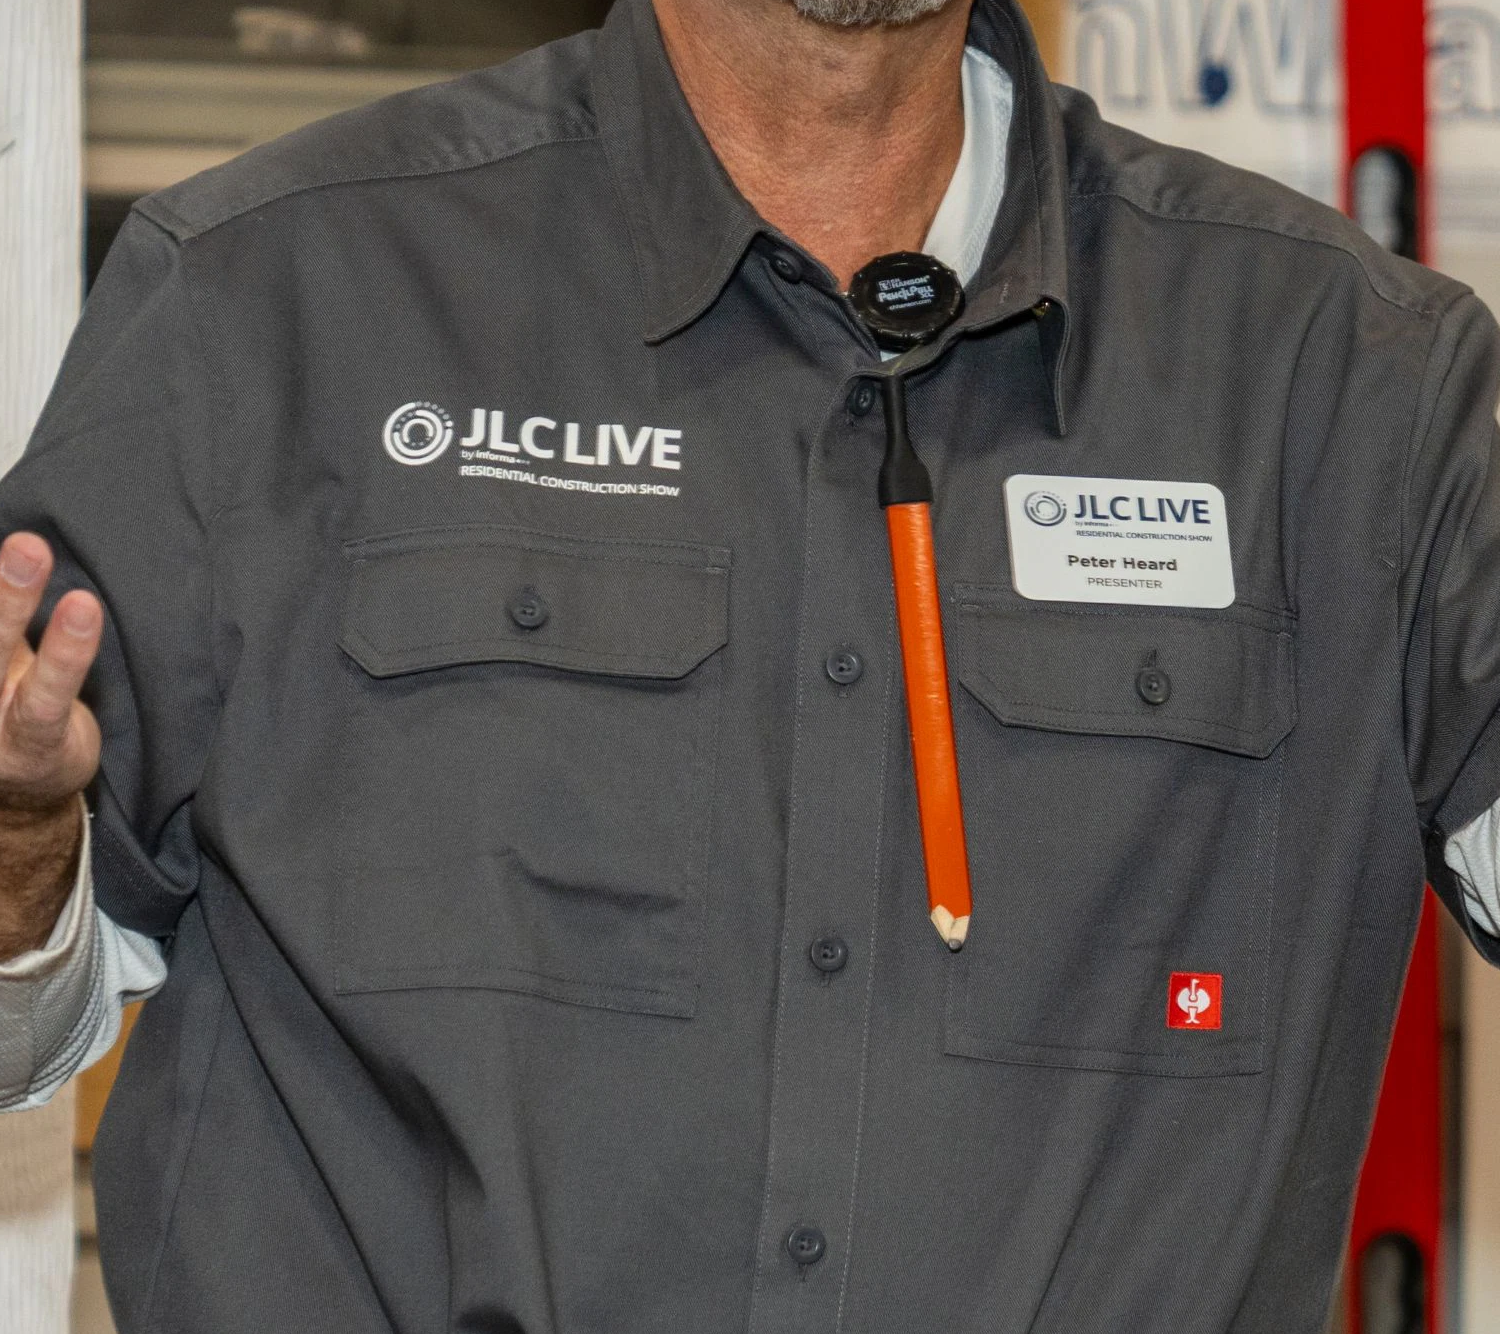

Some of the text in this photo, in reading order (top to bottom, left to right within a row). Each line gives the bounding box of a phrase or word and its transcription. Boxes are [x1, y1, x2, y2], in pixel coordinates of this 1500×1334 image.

[460, 408, 681, 470] JLC LIVE
[461, 450, 515, 463] by informa
[460, 466, 680, 497] RESIDENTIAL CONSTRUCTION SHOW
[1074, 494, 1211, 524] JLC LIVE
[1076, 530, 1124, 538] RESIDENTIAL
[1126, 532, 1187, 541] CONSTRUCTION
[1067, 554, 1178, 571] Peter Heard
[1087, 577, 1163, 589] PRESENTER
